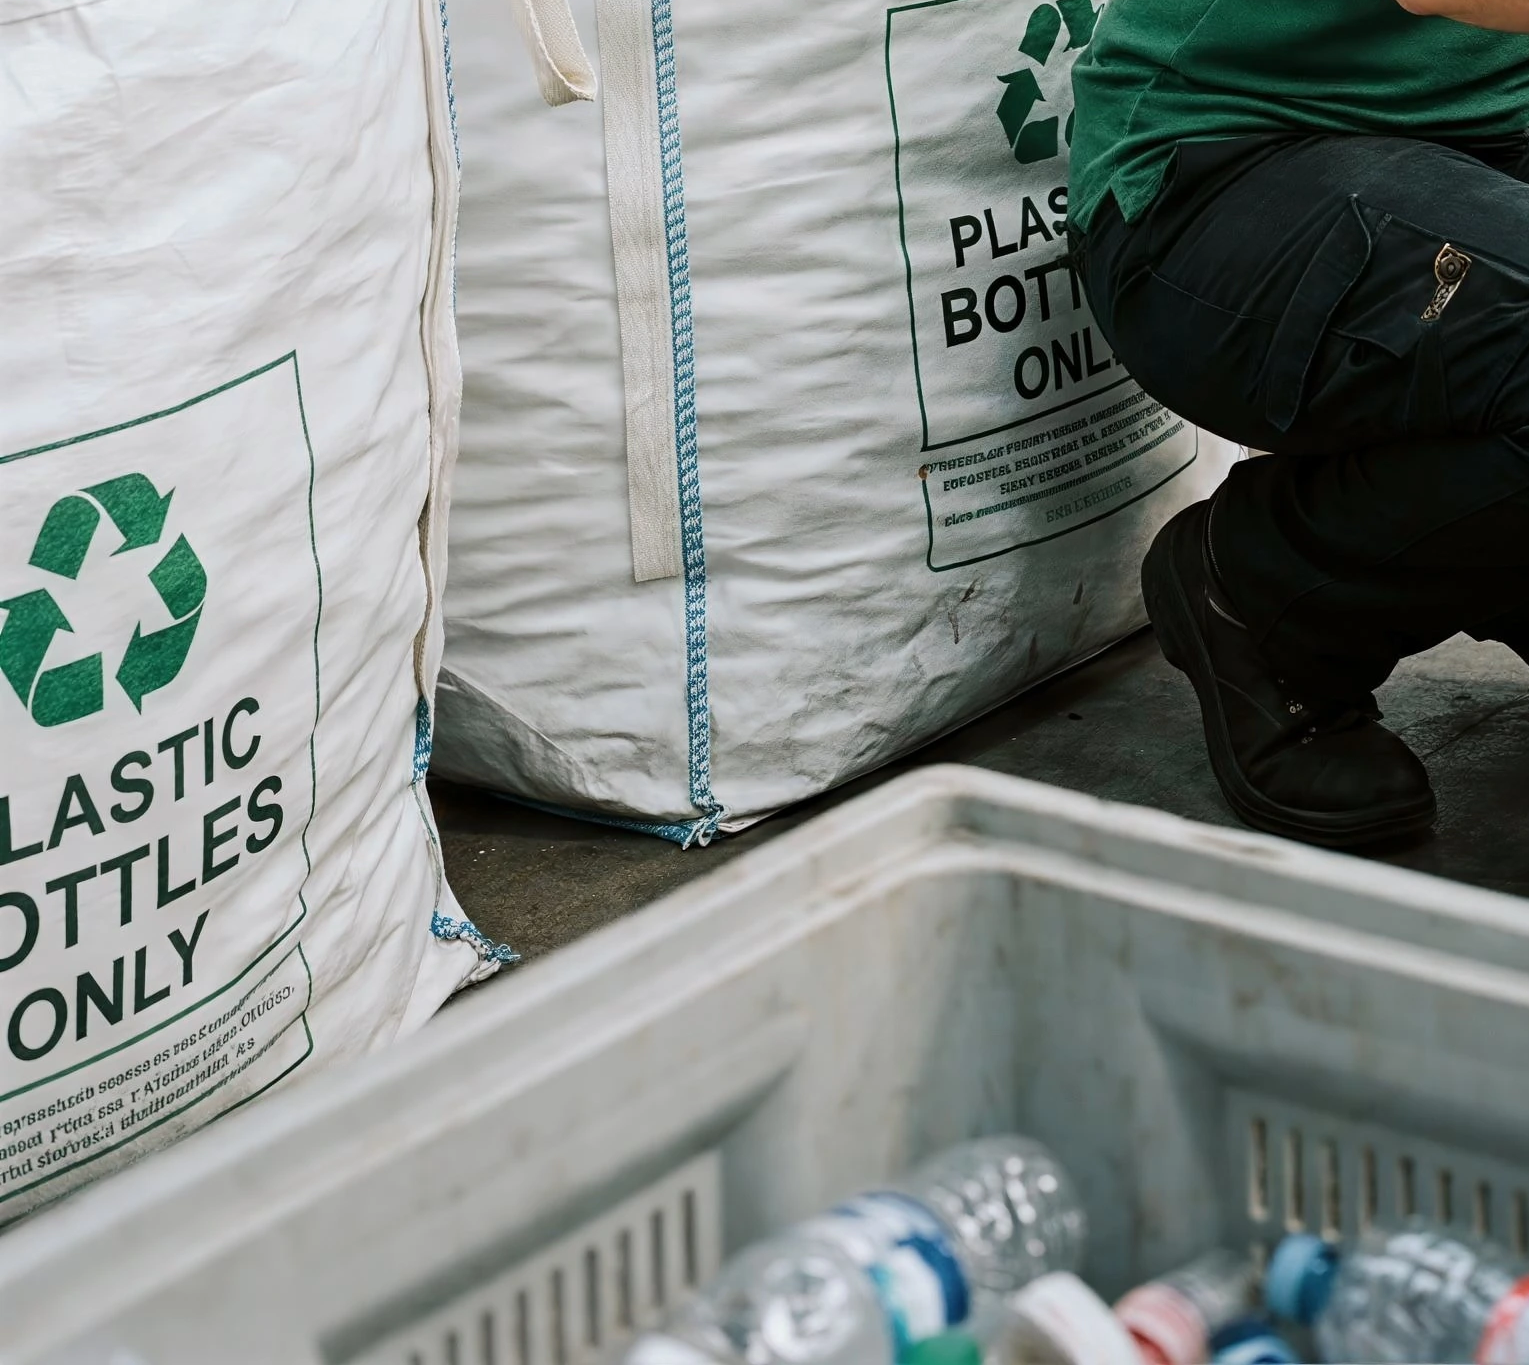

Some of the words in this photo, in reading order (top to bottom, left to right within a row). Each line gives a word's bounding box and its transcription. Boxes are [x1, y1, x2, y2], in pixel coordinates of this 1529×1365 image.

[949, 186, 1069, 269] PLAS
[940, 254, 1082, 349] BOTT
[1013, 326, 1121, 400] ONL
[0, 696, 261, 866] LASTIC
[0, 775, 284, 971] OTTLES
[7, 909, 210, 1062] ONLY
